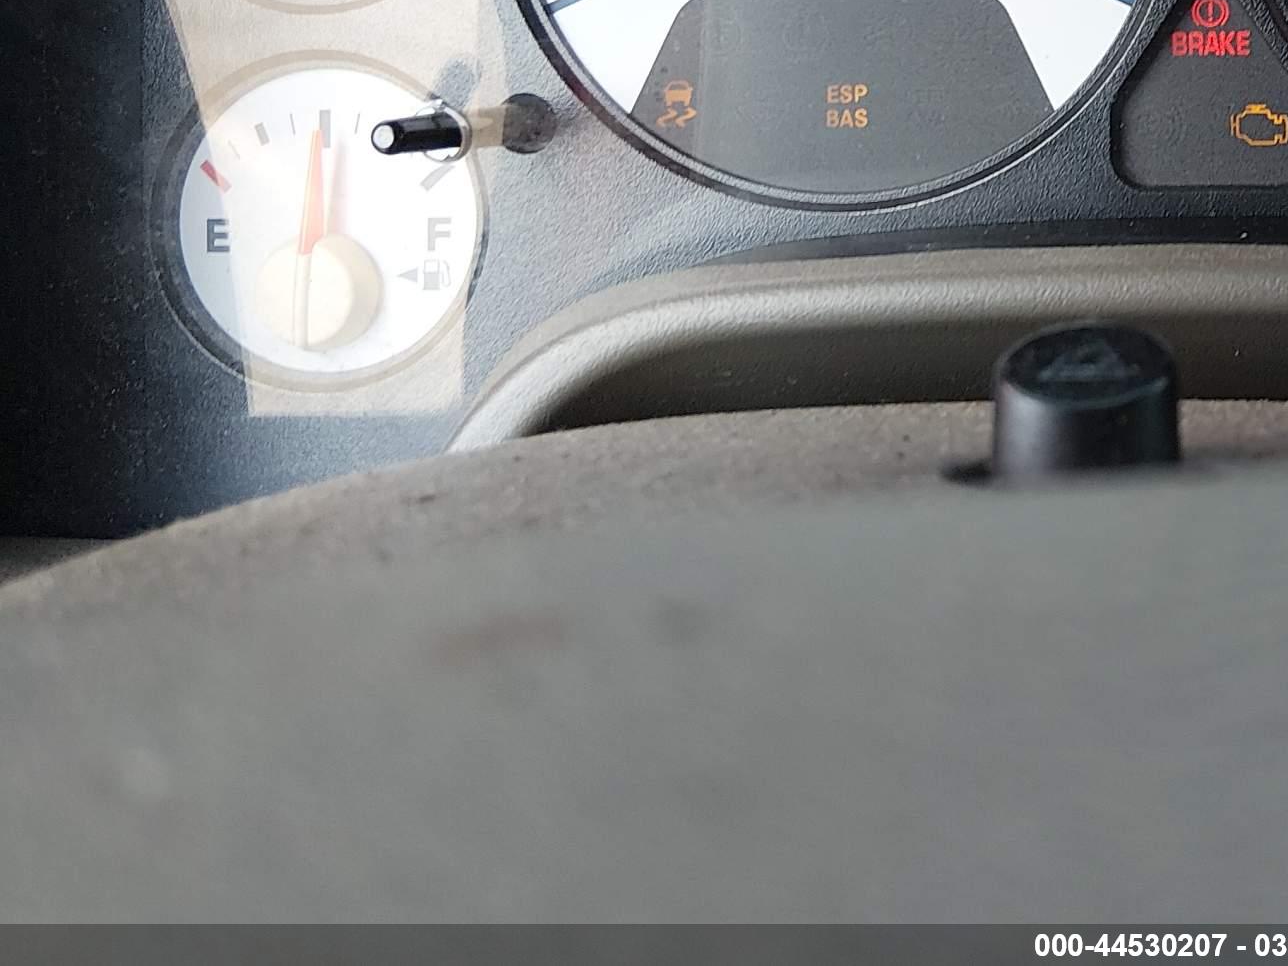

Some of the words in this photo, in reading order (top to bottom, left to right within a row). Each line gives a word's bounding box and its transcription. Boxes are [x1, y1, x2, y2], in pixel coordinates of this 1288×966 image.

[1171, 31, 1250, 56] BRAKE
[828, 85, 869, 103] ESP
[827, 109, 868, 127] BAS
[207, 219, 229, 253] E
[428, 217, 451, 252] F
